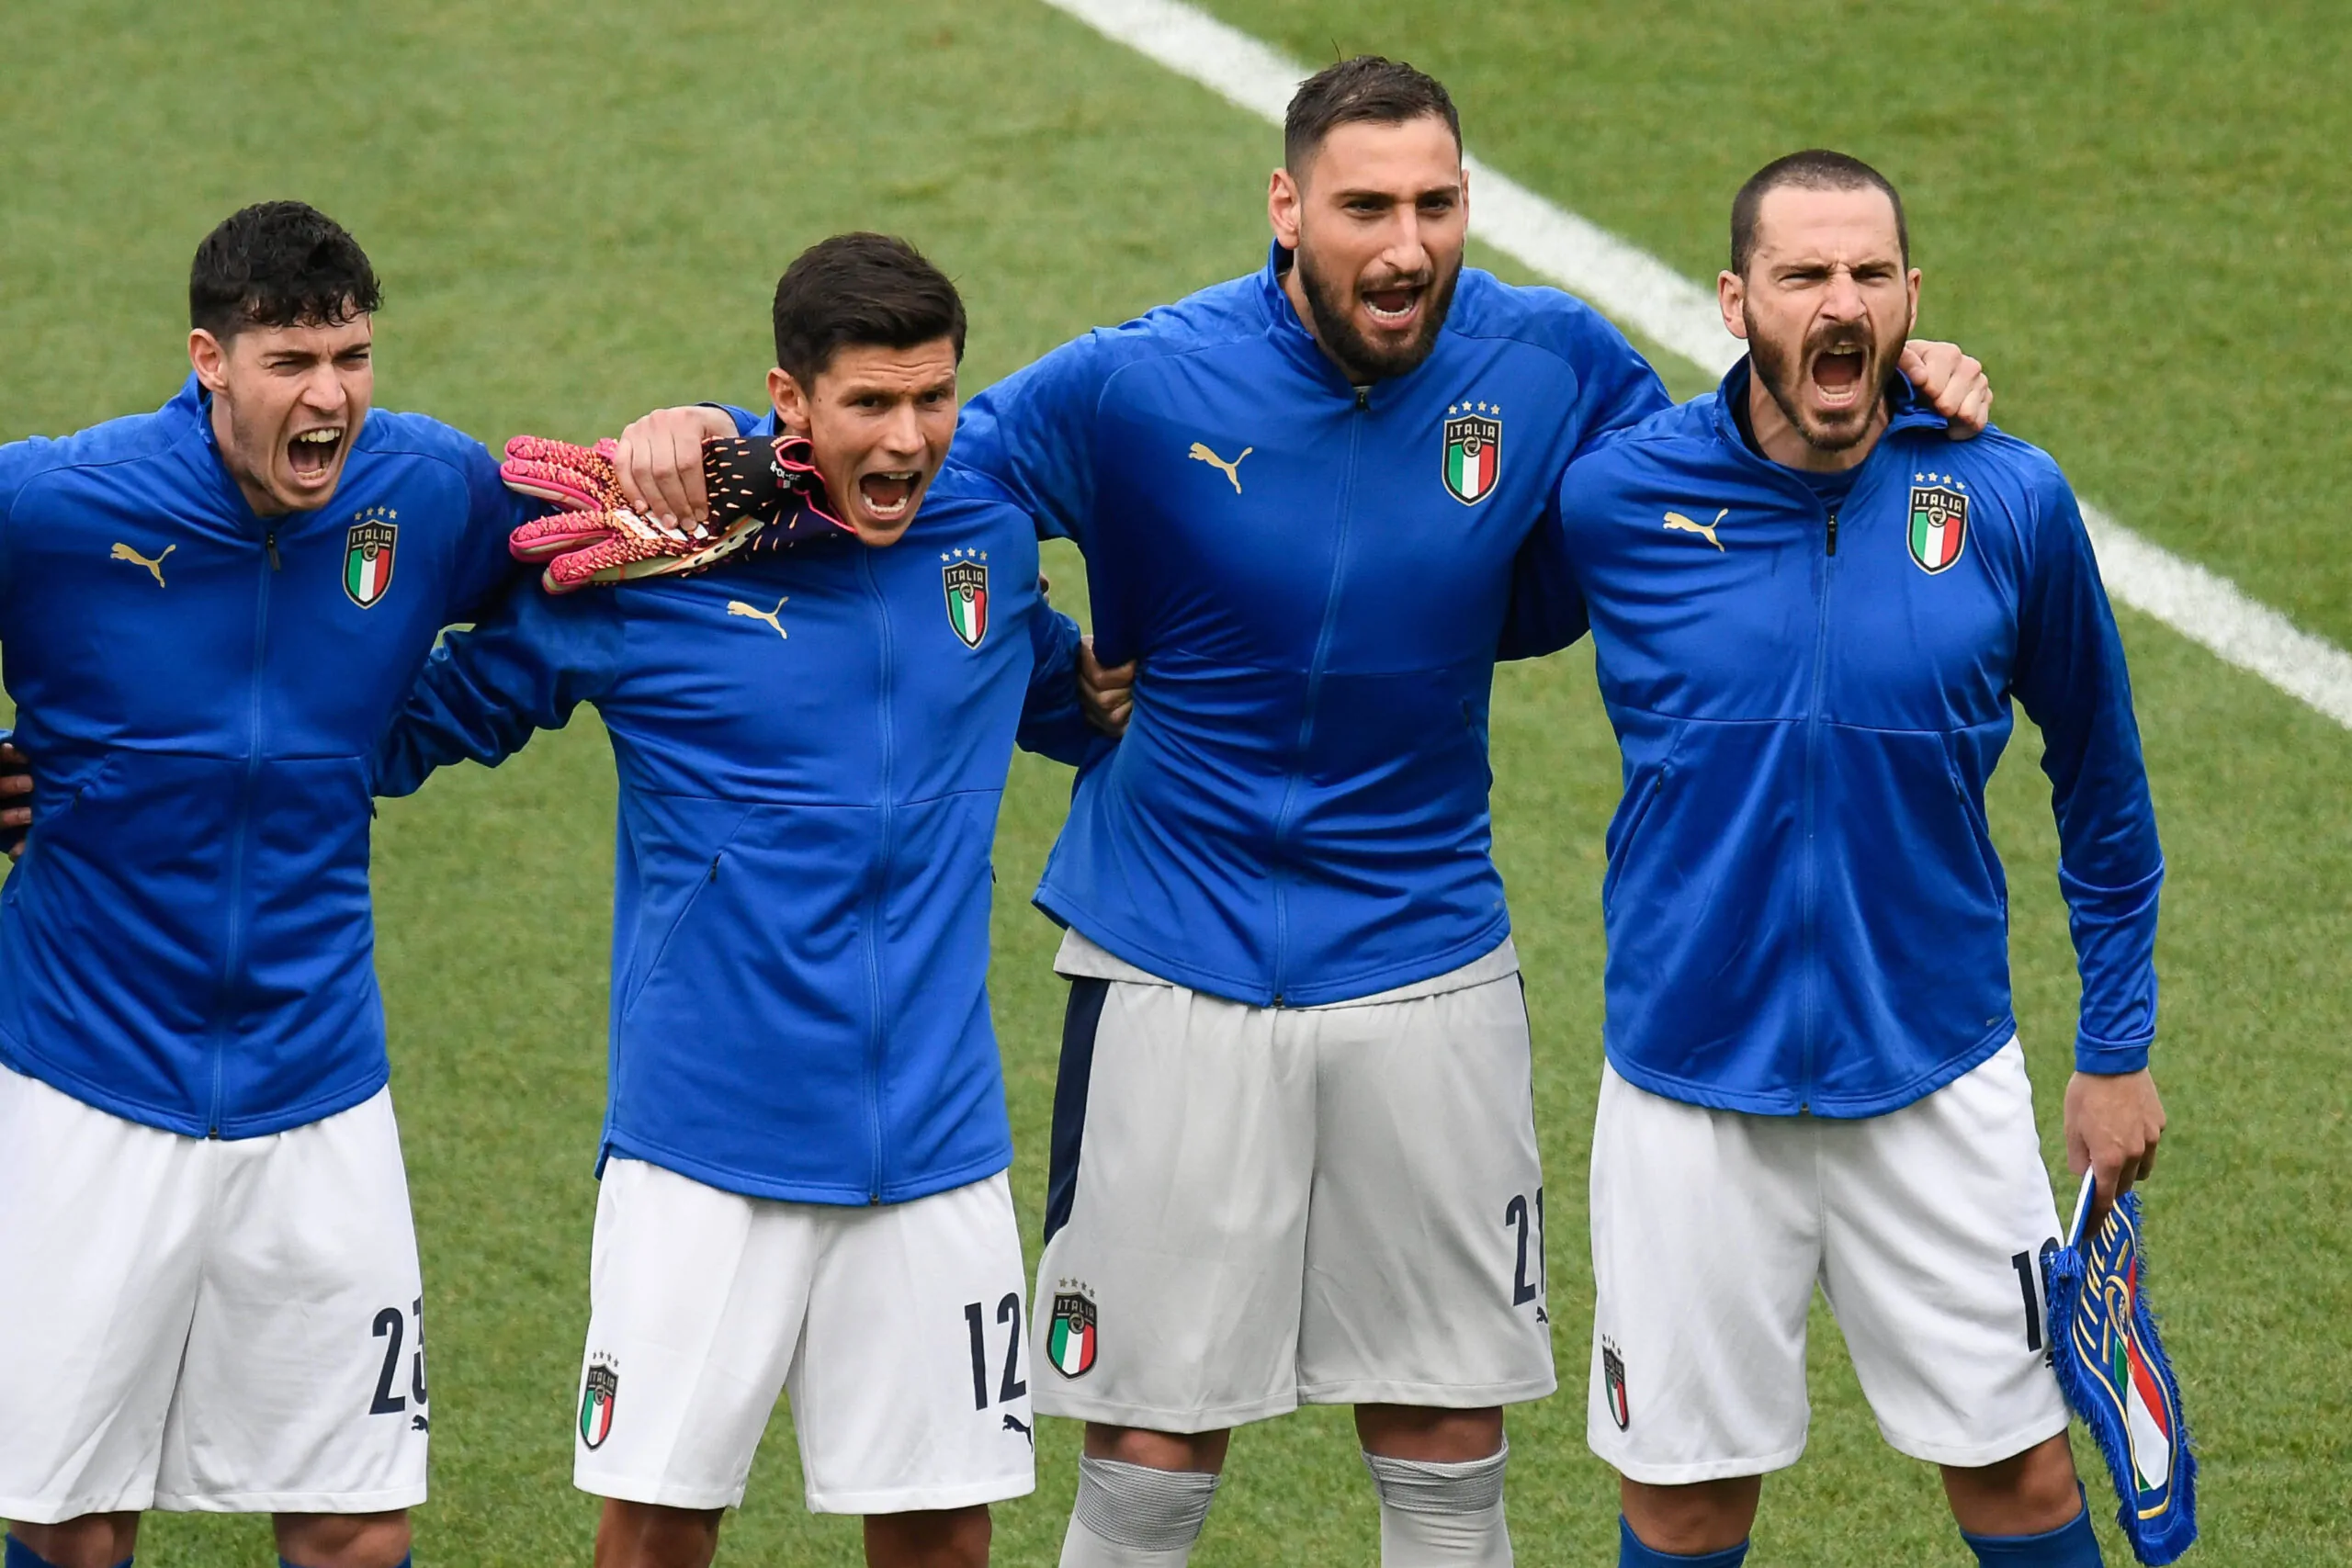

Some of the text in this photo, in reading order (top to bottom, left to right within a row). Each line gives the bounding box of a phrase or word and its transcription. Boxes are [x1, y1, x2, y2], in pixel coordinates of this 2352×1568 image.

[1450, 423, 1496, 438] ITALIA
[1915, 492, 1962, 512] ITALIA
[352, 528, 392, 543] ITALIA
[947, 570, 984, 583] ITALIA
[2011, 1236, 2060, 1352] 1
[1057, 1299, 1094, 1317] ITALIA
[964, 1292, 1027, 1412] 12
[588, 1371, 616, 1391] ITALIA
